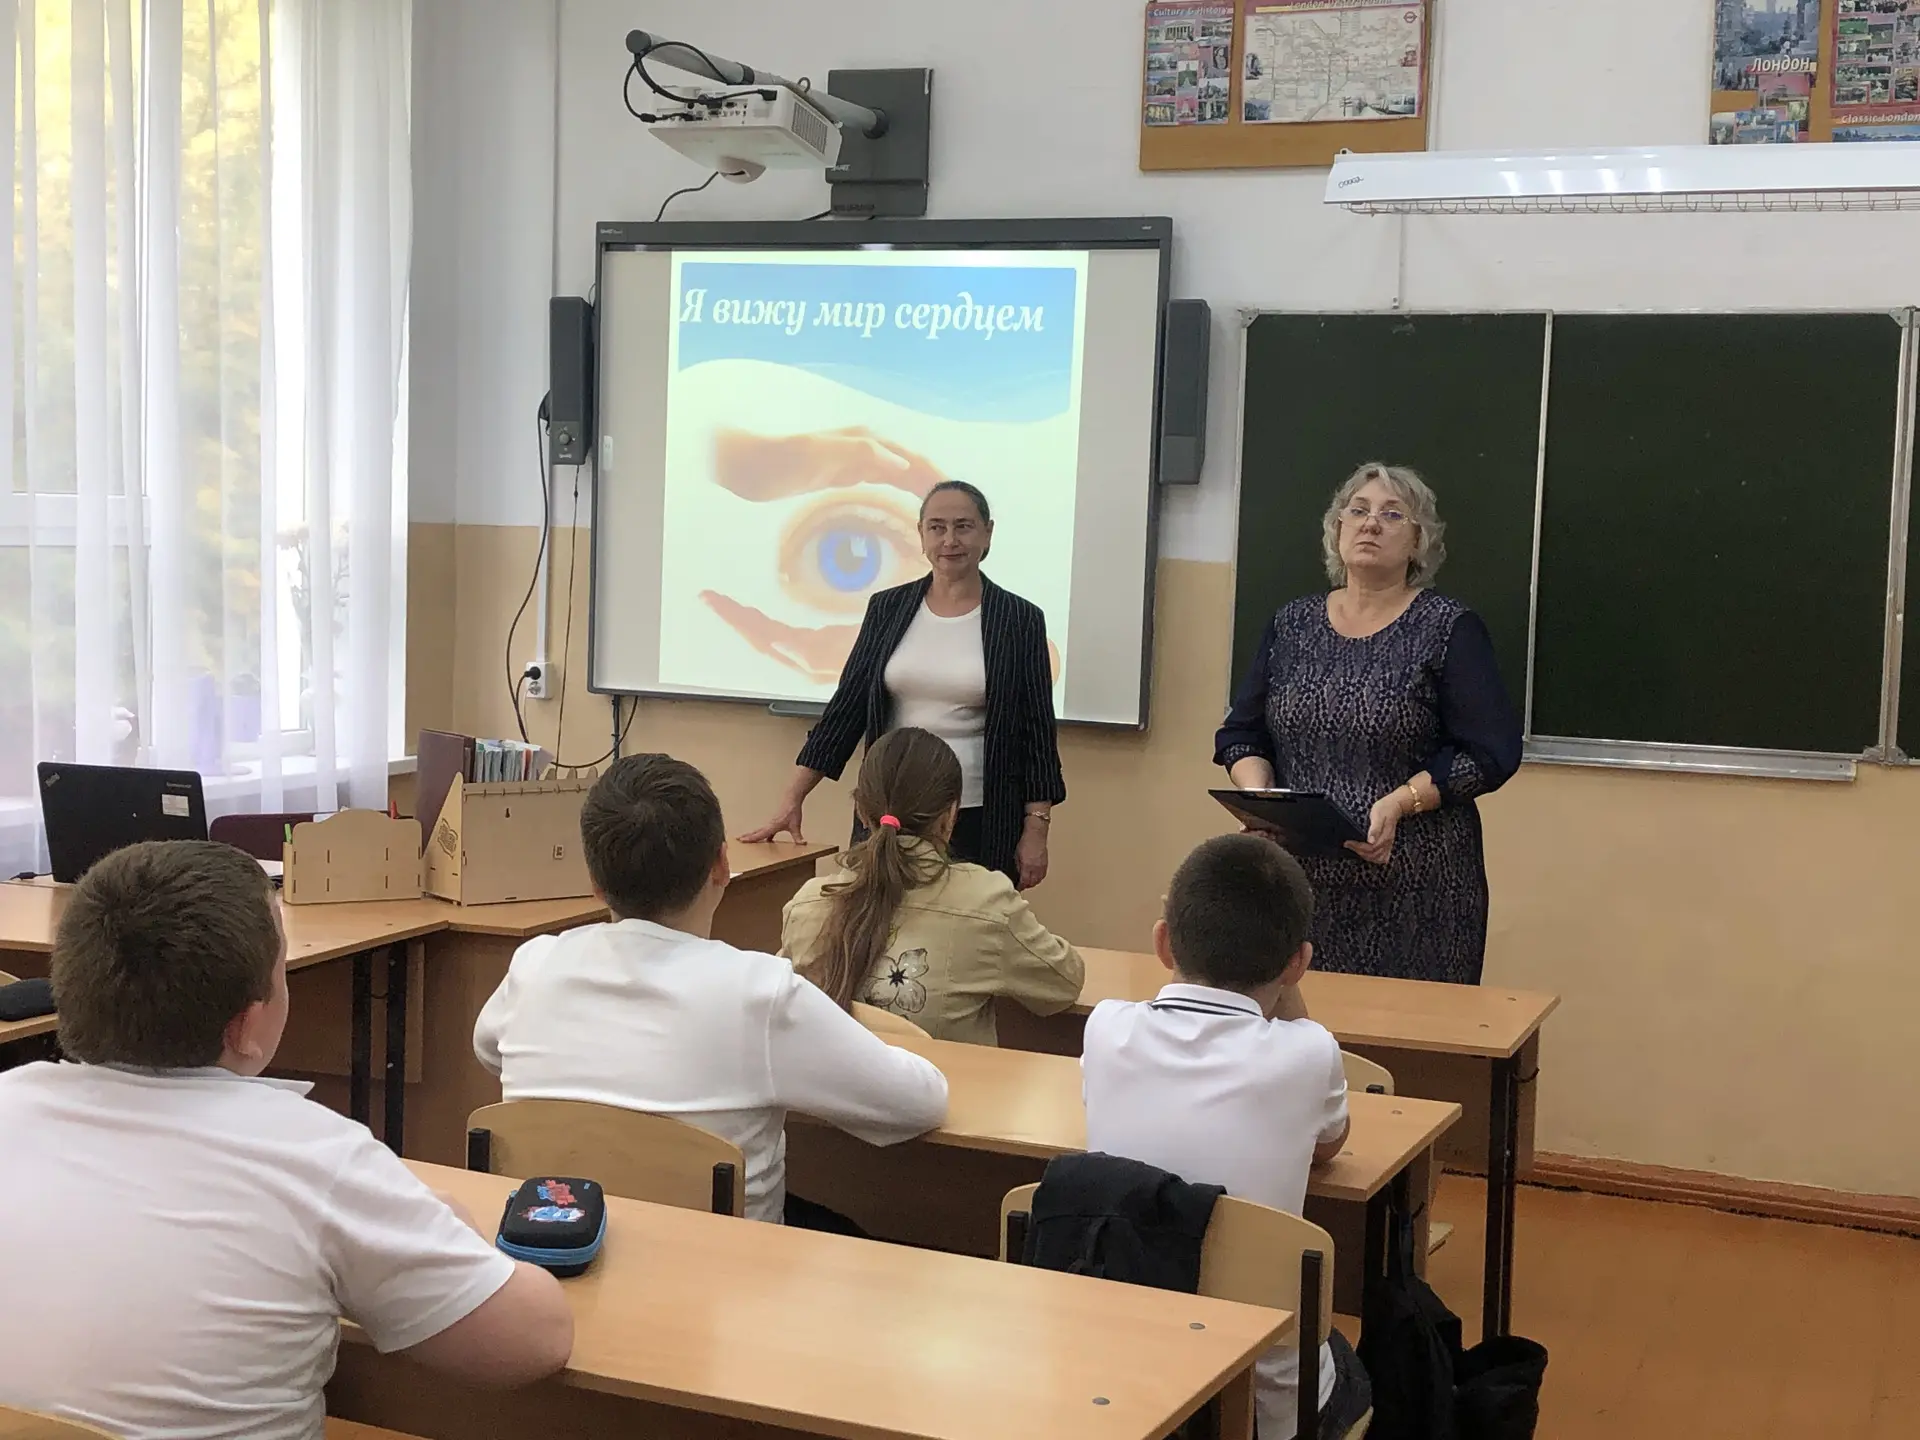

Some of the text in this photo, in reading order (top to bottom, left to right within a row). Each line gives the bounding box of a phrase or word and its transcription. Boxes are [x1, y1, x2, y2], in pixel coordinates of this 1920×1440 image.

[1153, 8, 1183, 17] Culture
[1198, 6, 1228, 16] History
[1751, 55, 1810, 71] Лондон
[1841, 111, 1920, 124] Classic London
[680, 289, 1044, 341] Я вижу мир сердцем
